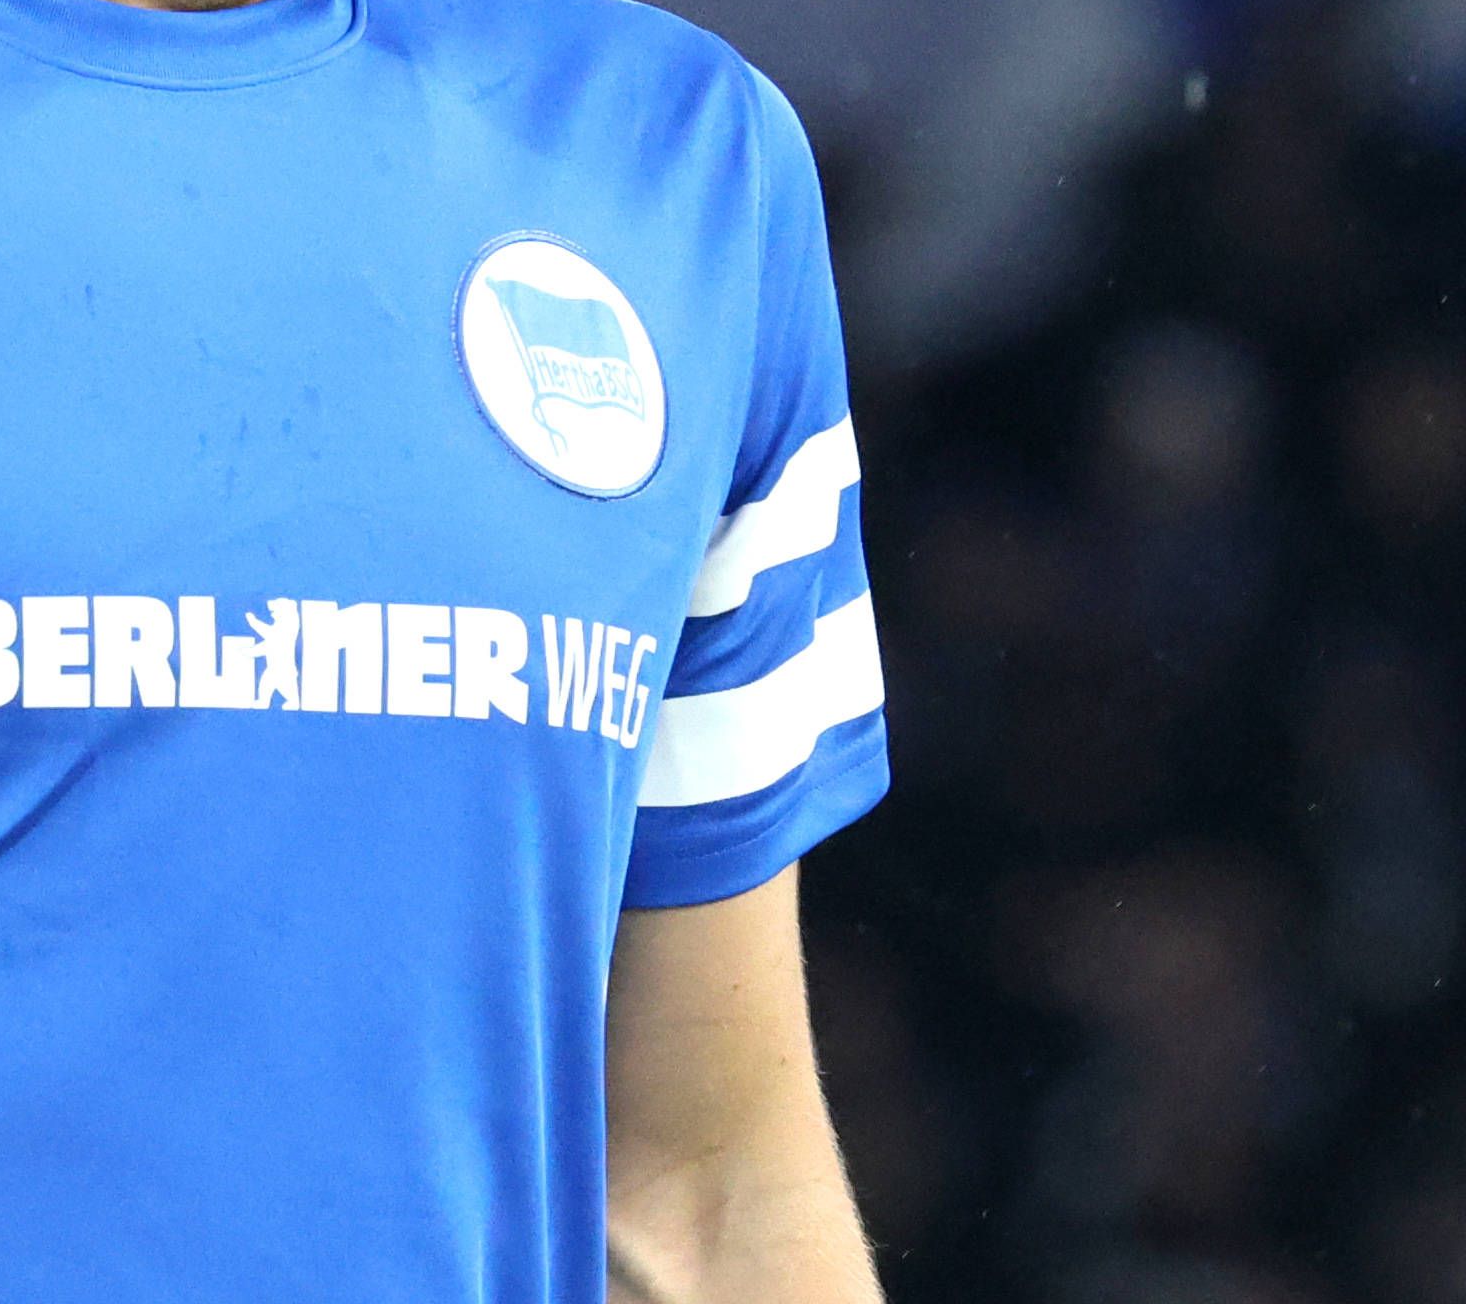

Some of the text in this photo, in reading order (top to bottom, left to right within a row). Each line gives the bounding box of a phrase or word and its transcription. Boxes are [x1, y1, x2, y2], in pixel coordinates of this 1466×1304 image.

[534, 350, 640, 406] Hertha BSC
[540, 613, 658, 750] WEG
